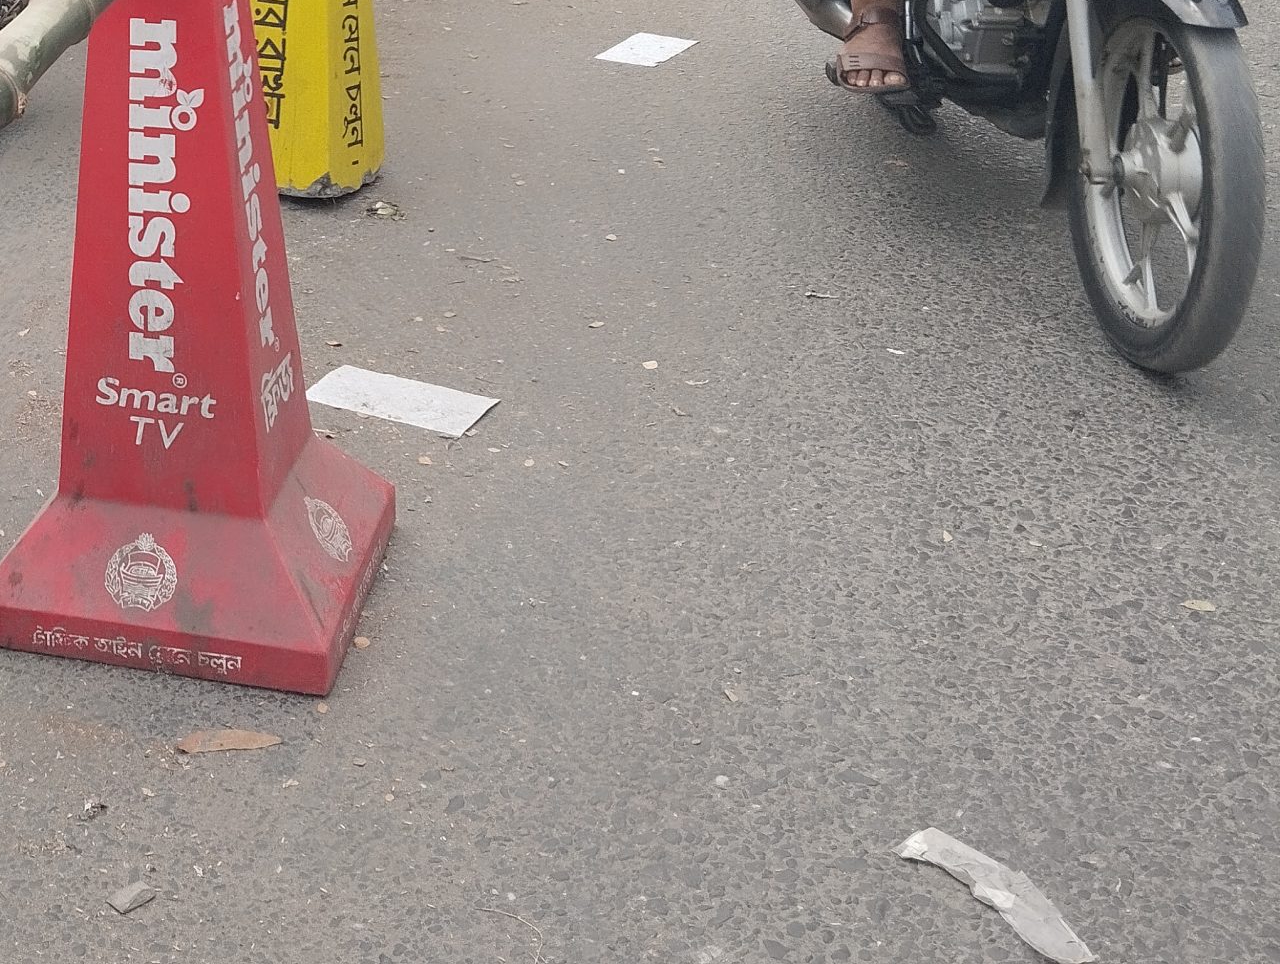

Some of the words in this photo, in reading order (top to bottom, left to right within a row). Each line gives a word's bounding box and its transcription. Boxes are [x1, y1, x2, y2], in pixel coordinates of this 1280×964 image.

[342, 13, 361, 76] মেনে
[128, 17, 193, 374] minister
[95, 376, 217, 419] Smart
[129, 415, 185, 450] TV
[94, 636, 143, 659] আইন
